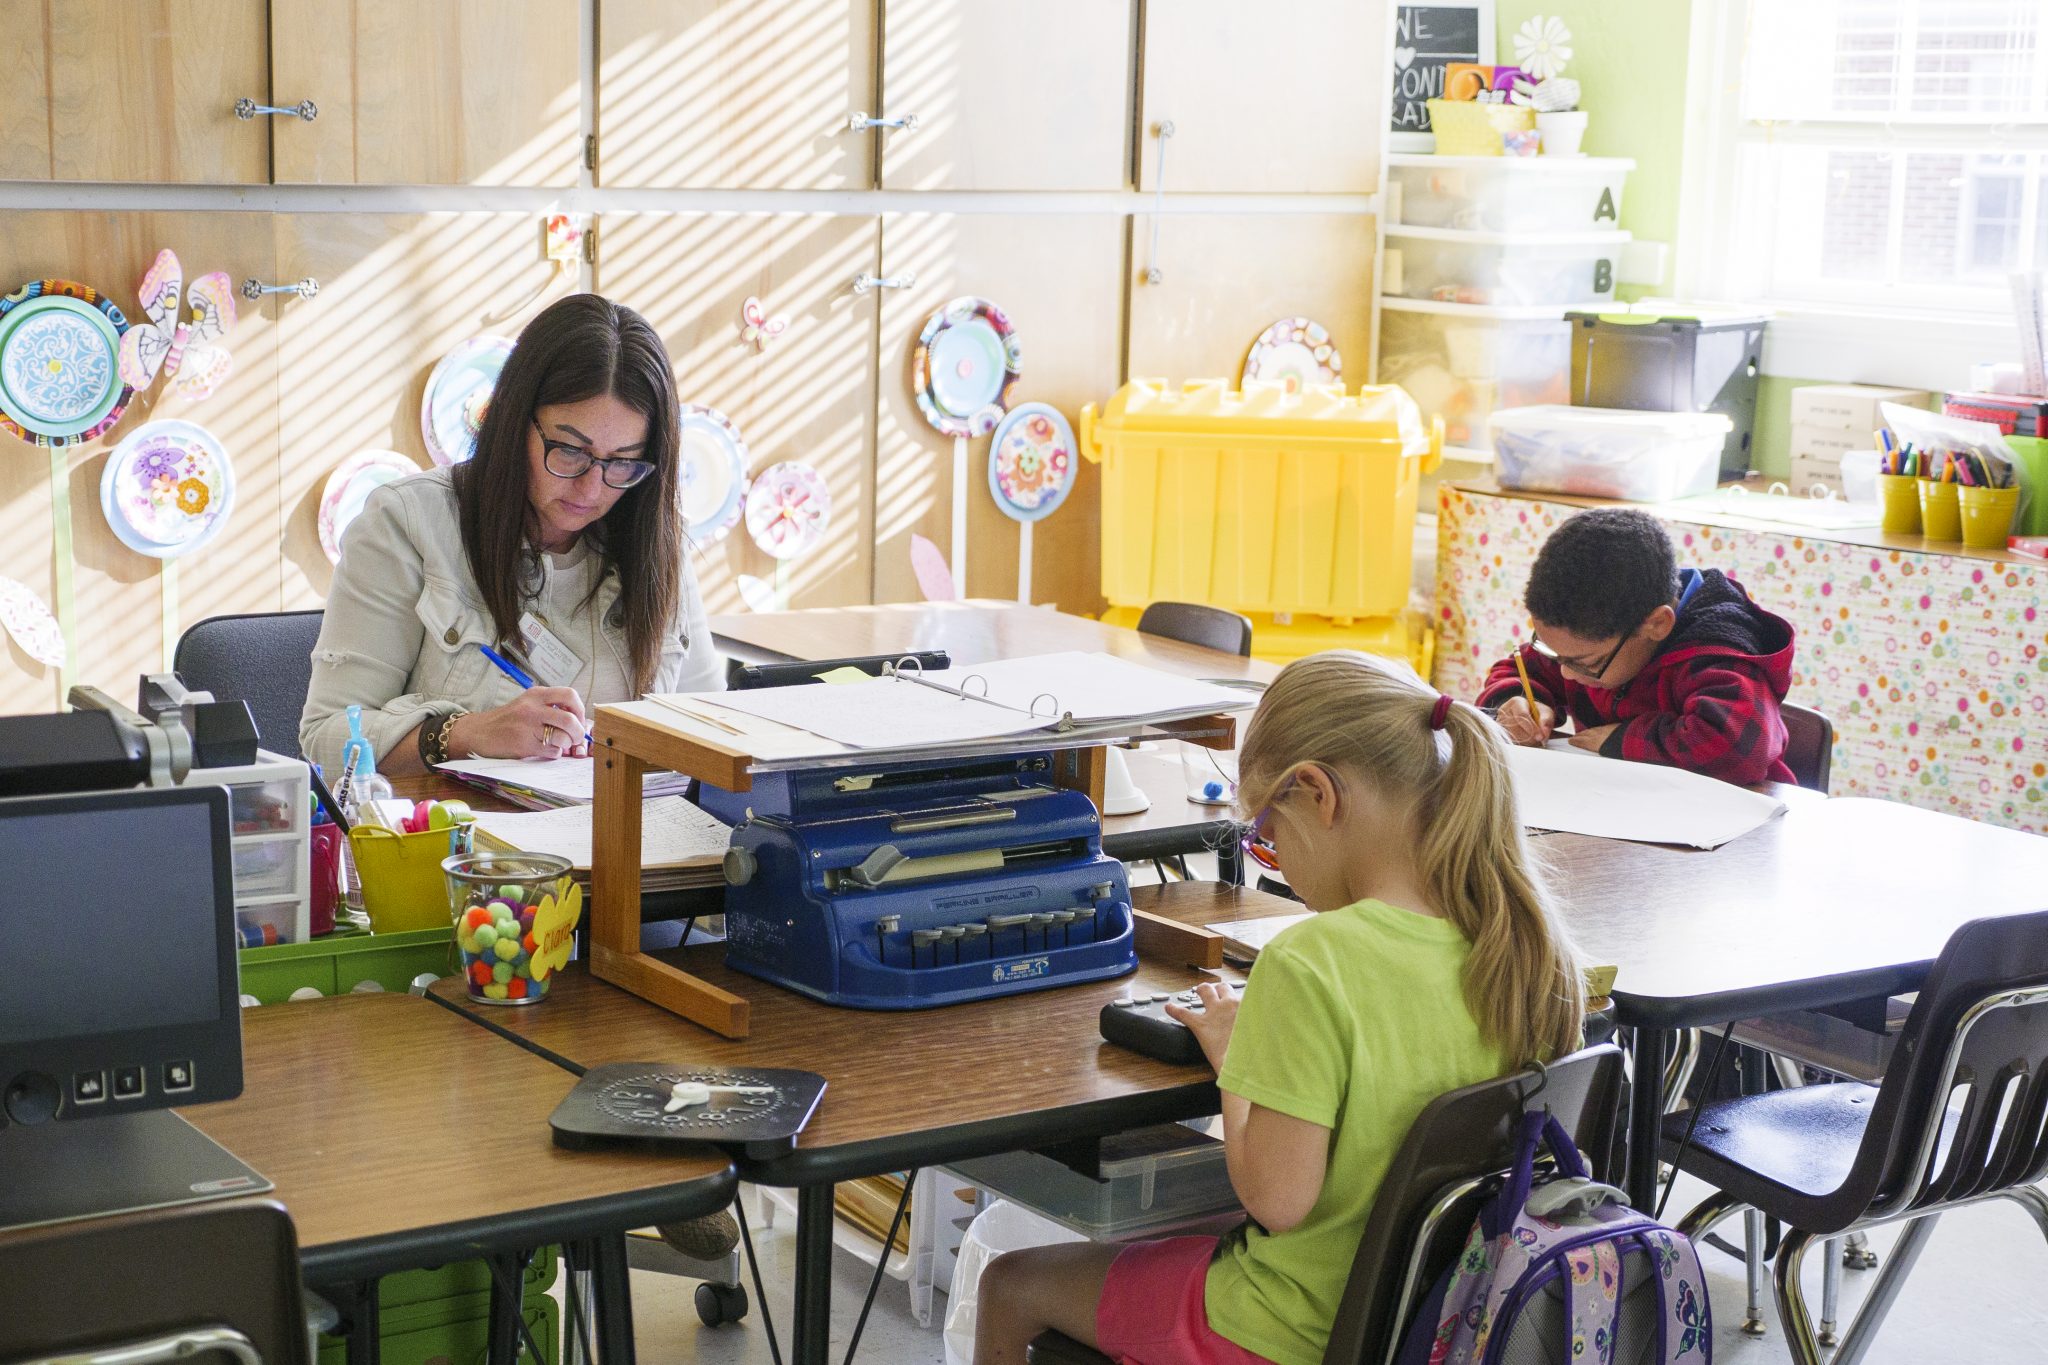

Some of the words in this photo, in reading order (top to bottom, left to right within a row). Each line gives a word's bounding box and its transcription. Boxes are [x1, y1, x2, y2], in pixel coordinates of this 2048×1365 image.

[1593, 186, 1616, 222] A
[1594, 258, 1612, 293] B
[656, 1076, 682, 1084] 2
[691, 1075, 717, 1084] 3
[743, 1098, 769, 1106] 6
[662, 1114, 689, 1123] 9
[698, 1112, 726, 1121] 8
